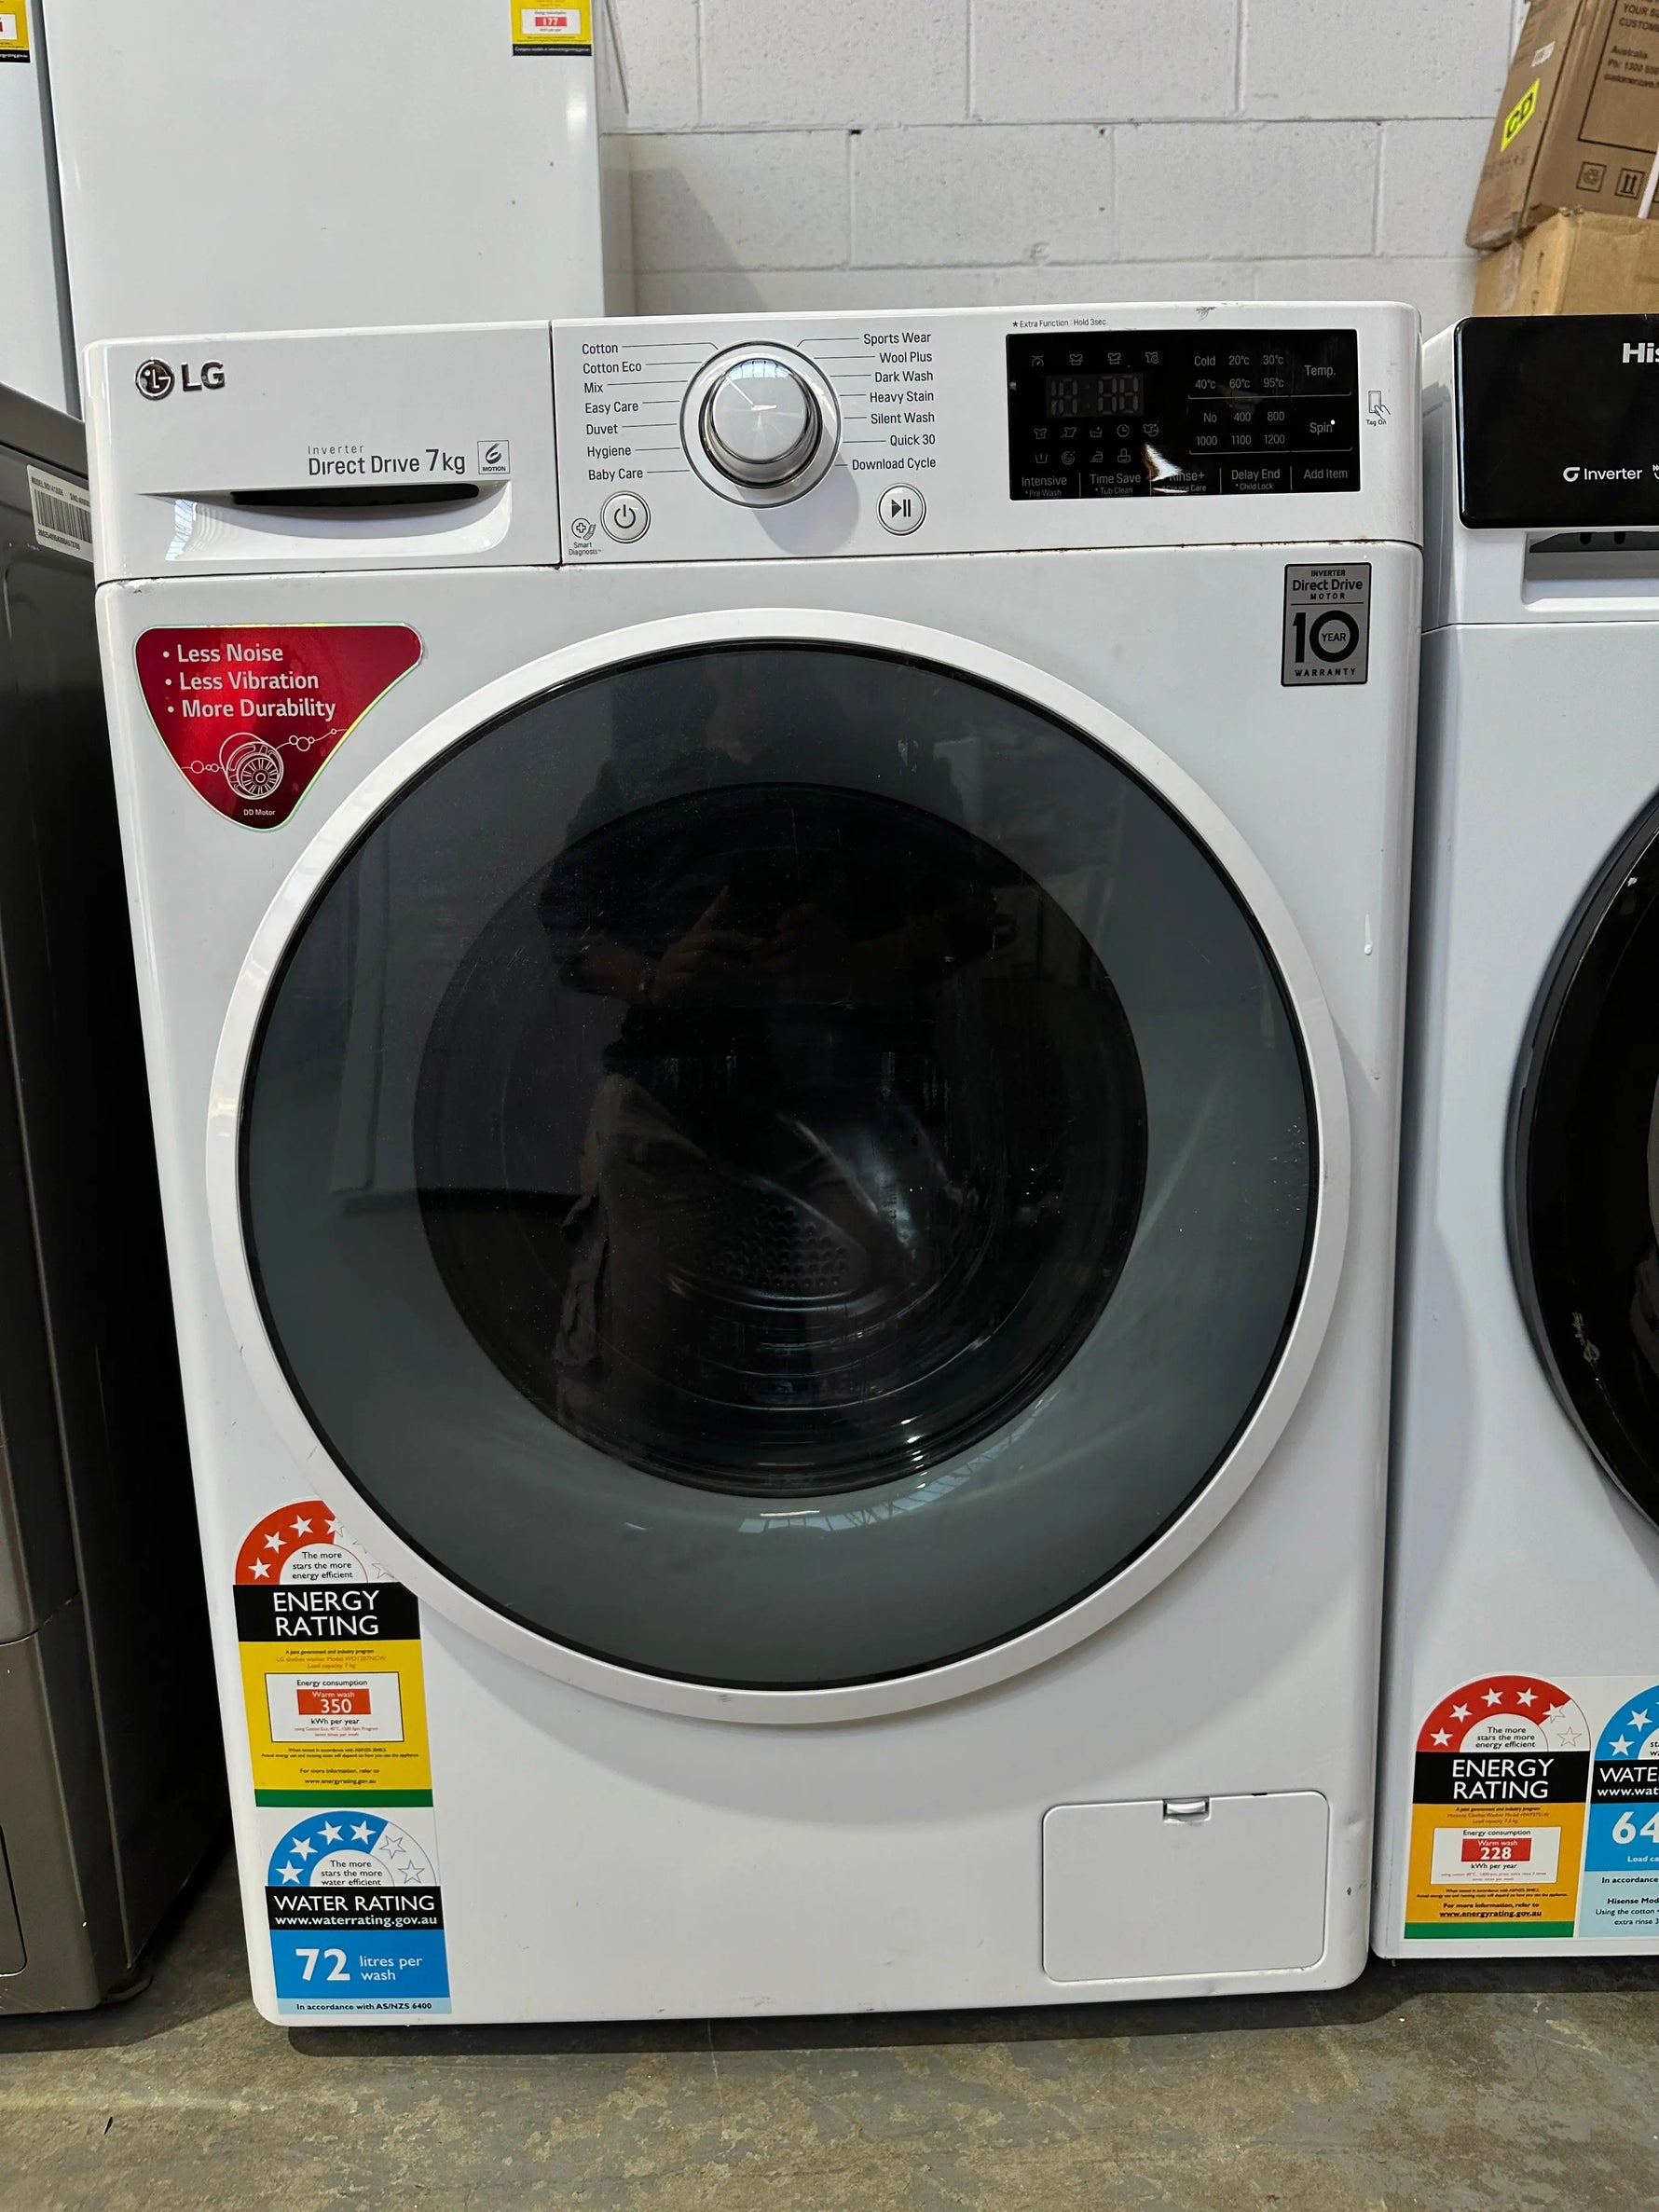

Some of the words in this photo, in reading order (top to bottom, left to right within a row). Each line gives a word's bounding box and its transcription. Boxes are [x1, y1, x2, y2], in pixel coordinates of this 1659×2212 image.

[1020, 320, 1038, 328] Extra
[1039, 319, 1069, 327] Function
[1073, 318, 1090, 326] Hold
[1090, 318, 1106, 326] 3sec
[863, 334, 899, 346] Sports
[902, 332, 932, 343] Wear
[582, 344, 619, 354] Cotton
[879, 352, 907, 364] Wool
[910, 351, 933, 363] Plus
[1194, 355, 1215, 366] Cold
[583, 363, 619, 374] Cotton
[622, 361, 642, 372] Eco
[1305, 364, 1336, 378] Temp.
[181, 361, 226, 392] LG
[874, 371, 900, 383] Dark
[902, 371, 934, 381] Wash
[583, 382, 604, 393] Mix
[870, 392, 904, 405] Heavy
[906, 391, 934, 402] Stain
[585, 402, 610, 415] Easy
[613, 402, 639, 412] Care
[871, 413, 901, 424] Silent
[904, 412, 935, 423] Wash
[1203, 413, 1217, 423] No
[1234, 412, 1251, 421] 400
[1268, 411, 1284, 421] 800
[586, 424, 618, 435] Duvet
[1309, 422, 1333, 435] Spin
[890, 434, 920, 447] Quick
[922, 433, 936, 445] 30
[1196, 435, 1217, 446] 1000
[1231, 434, 1252, 445] 1100
[1264, 434, 1285, 445] 1200
[308, 446, 364, 455] Inverter
[587, 446, 632, 459] Hygiene
[308, 458, 365, 475] Direct
[371, 455, 419, 474] Drive
[852, 458, 905, 471] Download
[907, 457, 937, 471] Cycle
[588, 469, 616, 482] Baby
[618, 468, 643, 479] Care
[1090, 474, 1115, 485] Time
[1117, 473, 1141, 484] Save
[1231, 469, 1258, 481] Delay
[1261, 469, 1281, 479] End
[1304, 469, 1323, 480] Add
[1326, 469, 1348, 479] Item
[1584, 468, 1643, 481] Inverter
[1021, 475, 1067, 487] Intensive
[1240, 482, 1257, 490] Child
[1114, 487, 1133, 495] Clean
[1293, 579, 1328, 591] Direct
[1331, 579, 1364, 590] Drive
[1293, 610, 1360, 664] 10
[1322, 633, 1347, 642] YEAR
[177, 644, 221, 663] Less
[226, 643, 283, 662] Noise
[1295, 668, 1356, 677] WARRANTY
[179, 672, 223, 691] Less
[228, 671, 319, 690] Vibration
[182, 699, 234, 718] More
[240, 697, 336, 722] Durability
[254, 808, 276, 817] Motor
[292, 1573, 320, 1581] energy
[273, 1589, 380, 1613] ENERGY
[275, 1615, 379, 1637] RATING
[322, 1679, 368, 1687] consumption
[320, 1698, 352, 1714] 350
[1475, 1741, 1502, 1750] energy
[1452, 1758, 1555, 1778] ENERGY
[1453, 1780, 1549, 1799] RATING
[1480, 1847, 1512, 1861] 228
[329, 1860, 346, 1868] The
[273, 1895, 349, 1911] WATER
[354, 1895, 435, 1911] RATING
[1439, 1910, 1542, 1918] www.energyrating.gov.au
[1595, 1908, 1616, 1917] Using
[275, 1916, 437, 1928] www.waterrating.gov.au
[295, 1948, 351, 1982] 72
[360, 1956, 394, 1967] litres
[399, 1957, 423, 1970] per
[361, 1970, 396, 1981] wash
